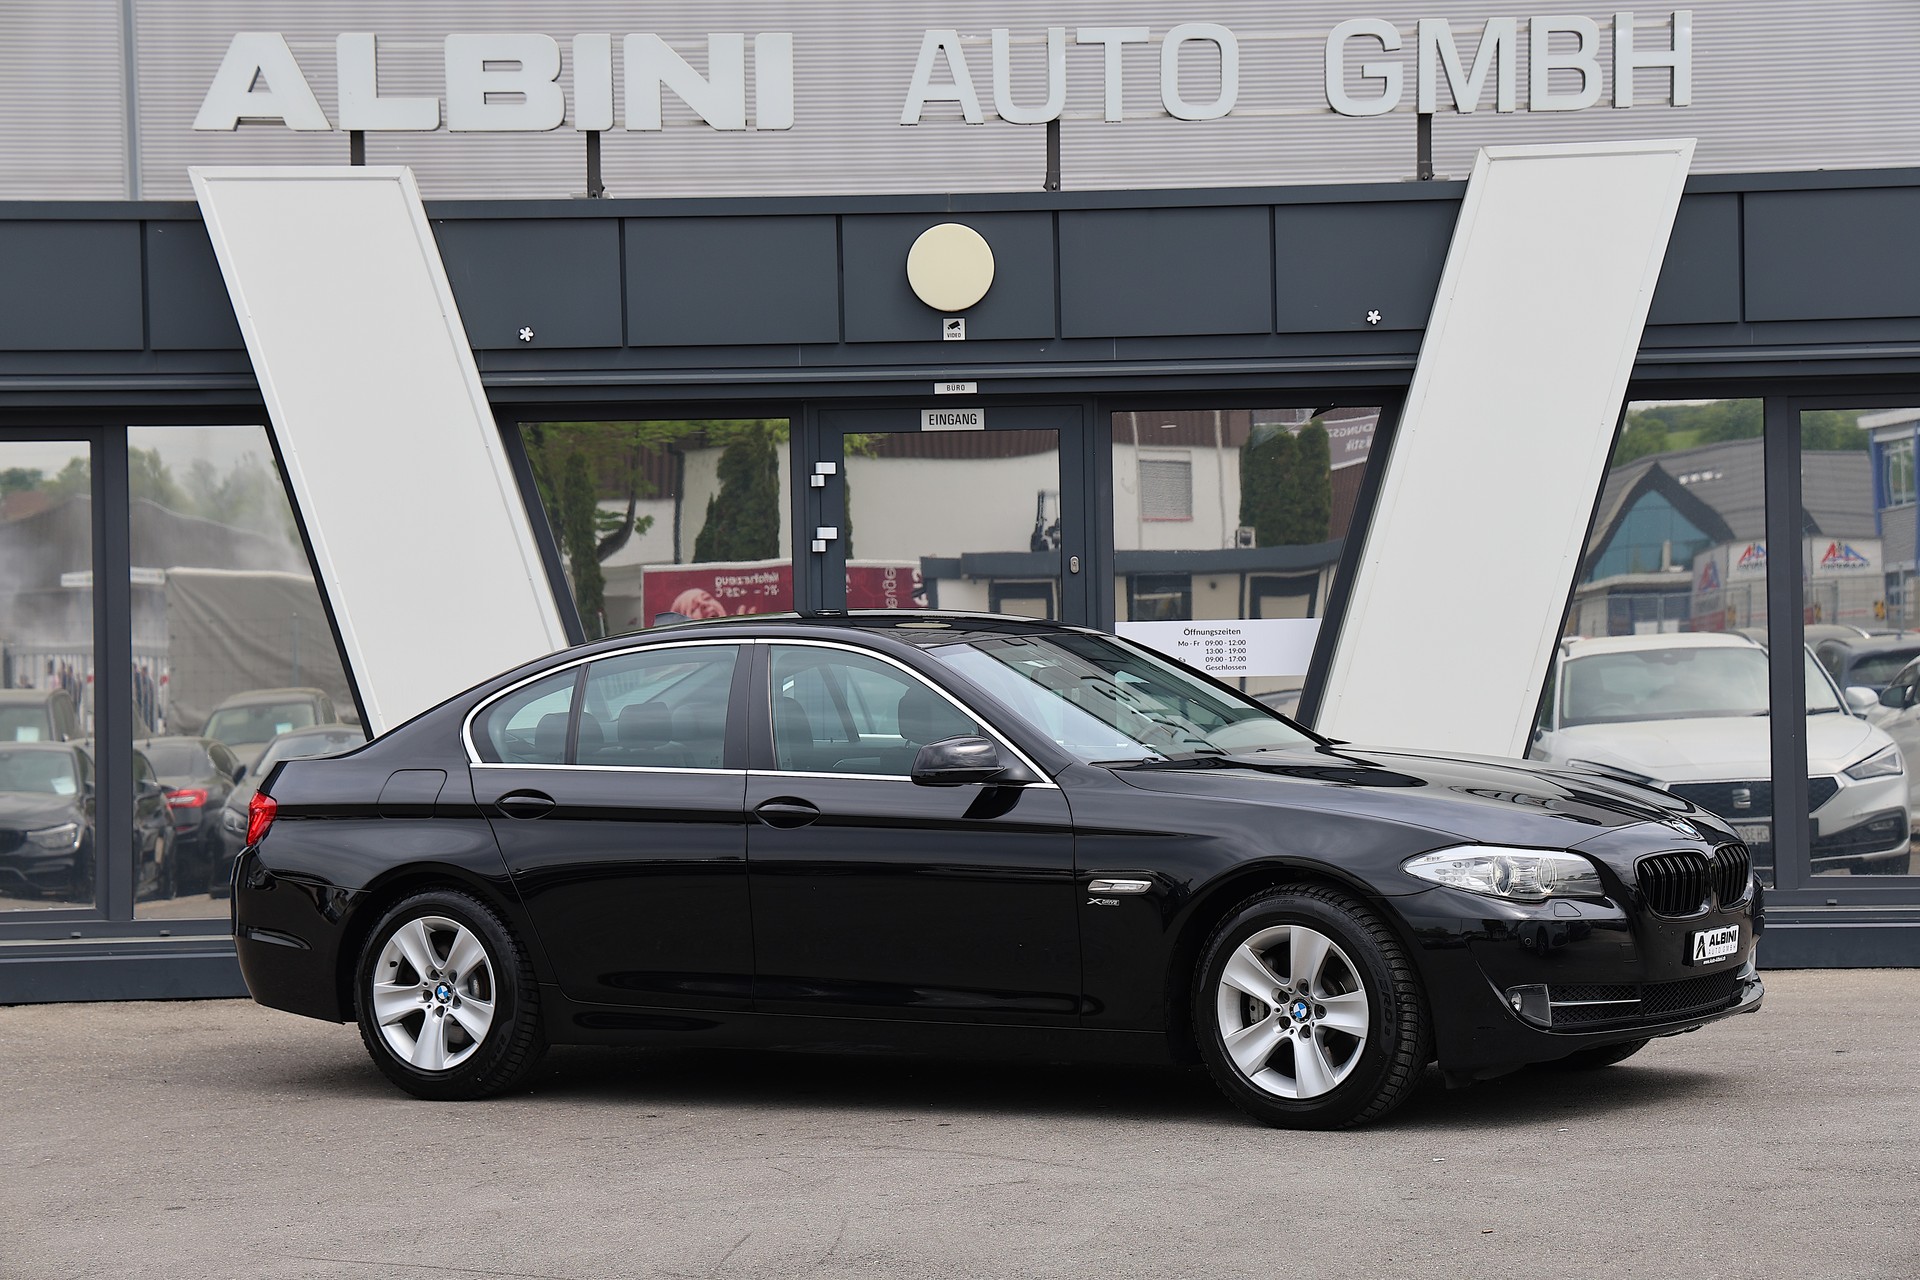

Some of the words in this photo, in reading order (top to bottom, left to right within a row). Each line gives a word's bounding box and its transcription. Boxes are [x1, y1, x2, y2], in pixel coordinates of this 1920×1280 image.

[193, 32, 795, 132] ALBINI
[900, 22, 1240, 127] AUTO
[1323, 9, 1693, 118] GMBH
[946, 384, 966, 392] BÜRO
[928, 413, 978, 426] EINGANG
[1183, 627, 1241, 637] Öffnungszeiten
[1709, 930, 1737, 947] ALBINI
[1708, 946, 1721, 955] AUTO
